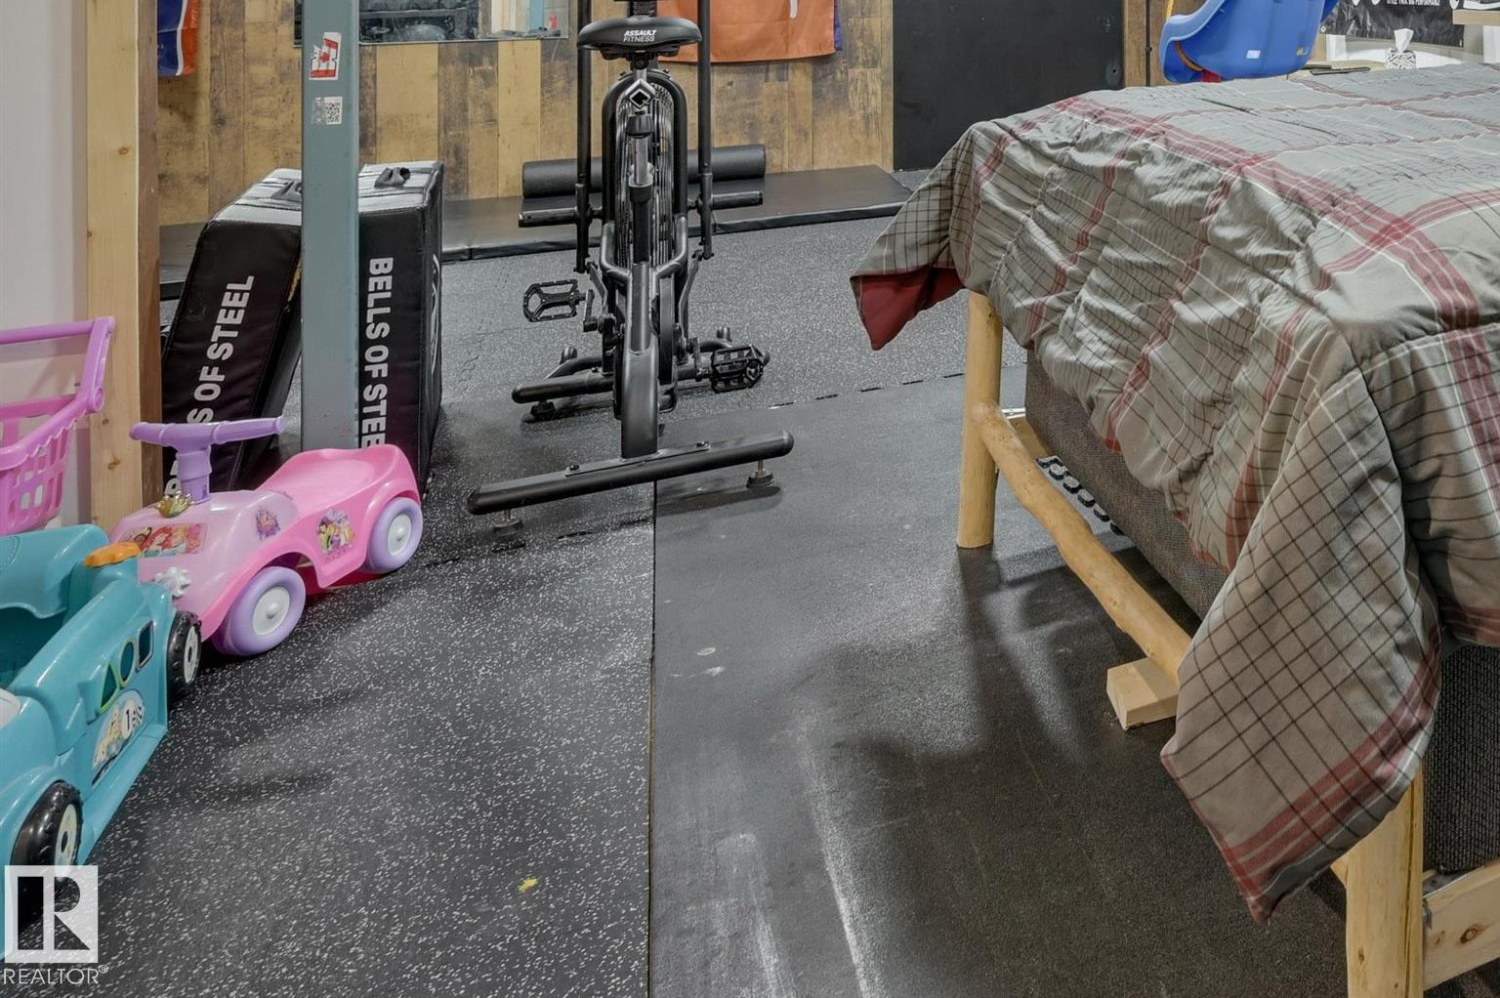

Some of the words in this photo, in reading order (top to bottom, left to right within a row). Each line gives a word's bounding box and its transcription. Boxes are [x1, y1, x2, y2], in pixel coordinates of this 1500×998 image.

[206, 275, 255, 361] STEEL
[365, 257, 394, 340] BELLS
[193, 366, 226, 402] OF
[364, 344, 389, 379] OF
[361, 383, 388, 450] STEE
